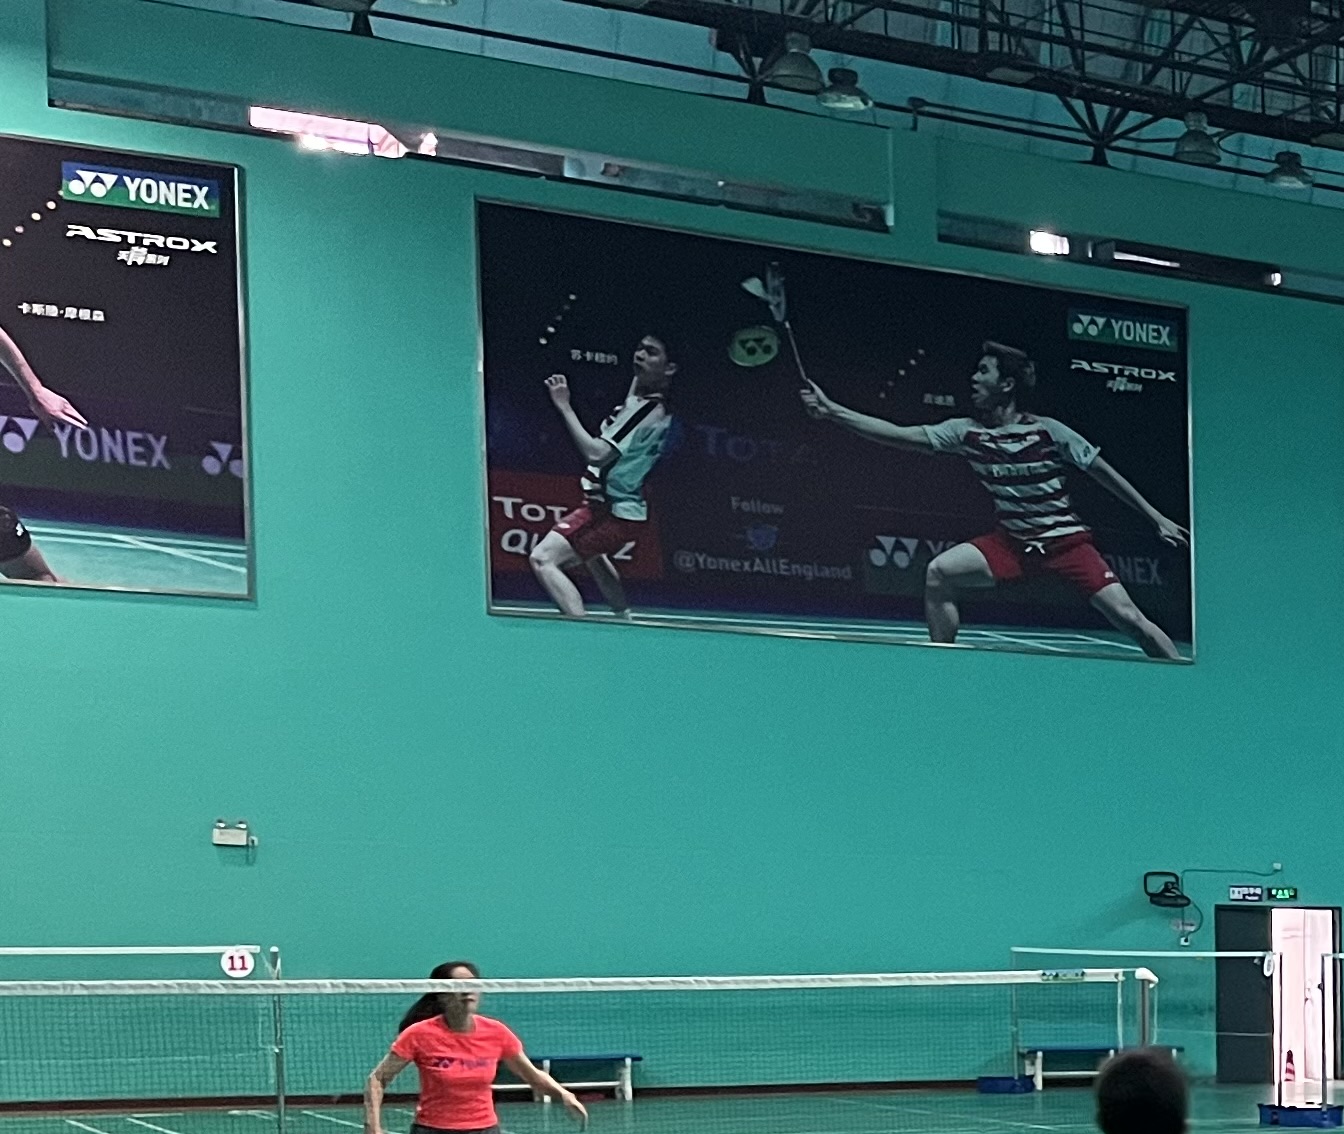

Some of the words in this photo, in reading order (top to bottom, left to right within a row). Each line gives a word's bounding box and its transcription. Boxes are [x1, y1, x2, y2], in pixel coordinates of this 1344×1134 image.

[123, 176, 209, 210] YONEX
[66, 224, 217, 254] ASTROX
[1110, 319, 1170, 346] YONEX
[1070, 358, 1177, 382] ASTROX
[54, 421, 171, 470] YONEX
[228, 955, 249, 971] 11
